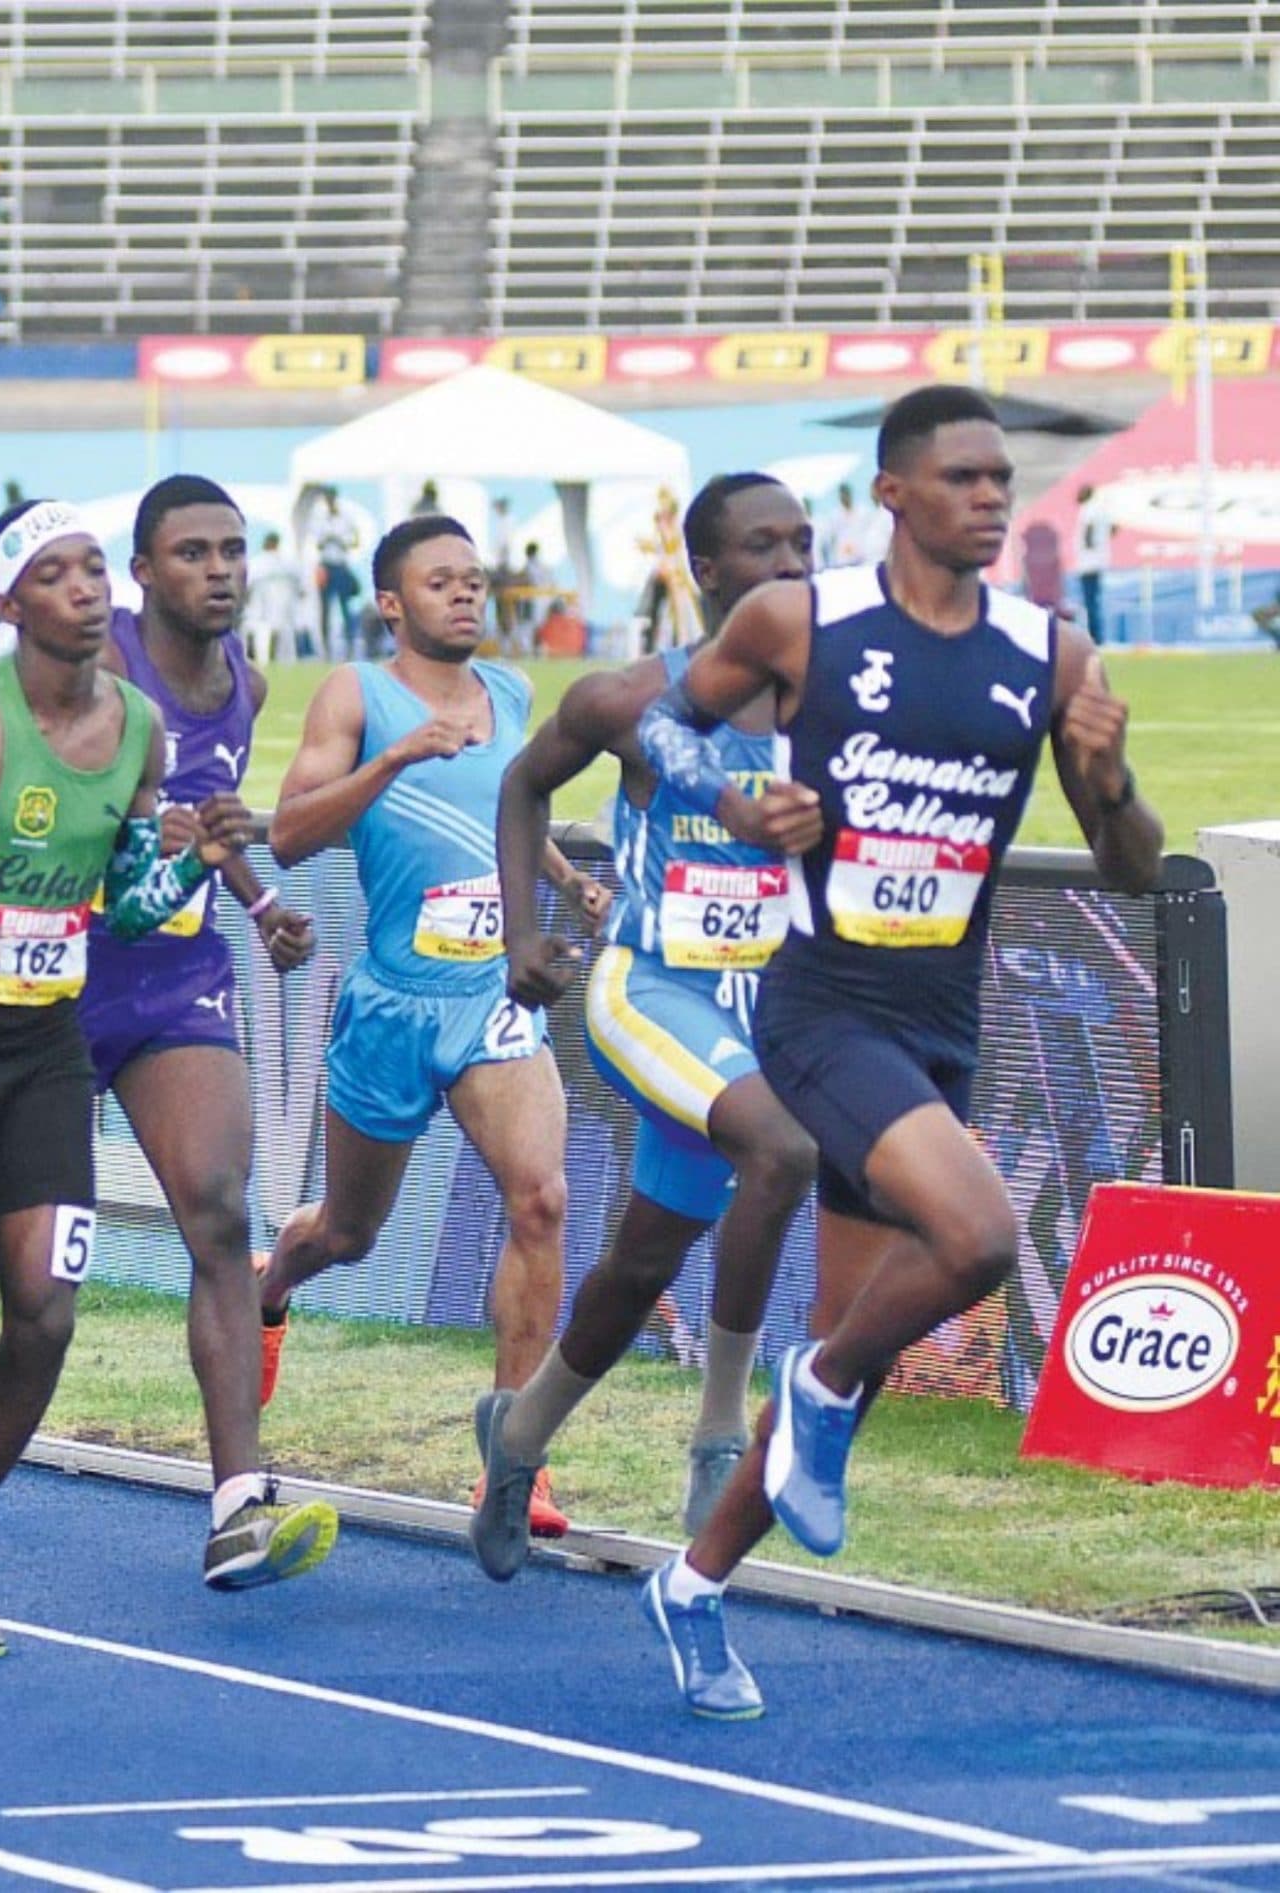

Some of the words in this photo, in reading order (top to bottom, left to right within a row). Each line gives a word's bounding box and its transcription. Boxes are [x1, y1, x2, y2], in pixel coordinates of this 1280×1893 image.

[829, 732, 1018, 798] Jamaica
[843, 782, 995, 845] College
[857, 839, 938, 870] PUMA
[685, 867, 759, 899] PUMA
[873, 875, 939, 914] 640
[0, 907, 68, 937] PUMA
[468, 901, 500, 937] 75
[702, 902, 762, 939] 624
[13, 942, 67, 975] 162
[494, 1003, 525, 1047] 2
[63, 1216, 90, 1274] 5
[1080, 1255, 1159, 1297] QUALITY
[1163, 1253, 1214, 1279] SINCE
[1216, 1271, 1249, 1315] 1922
[1090, 1314, 1211, 1373] Grace
